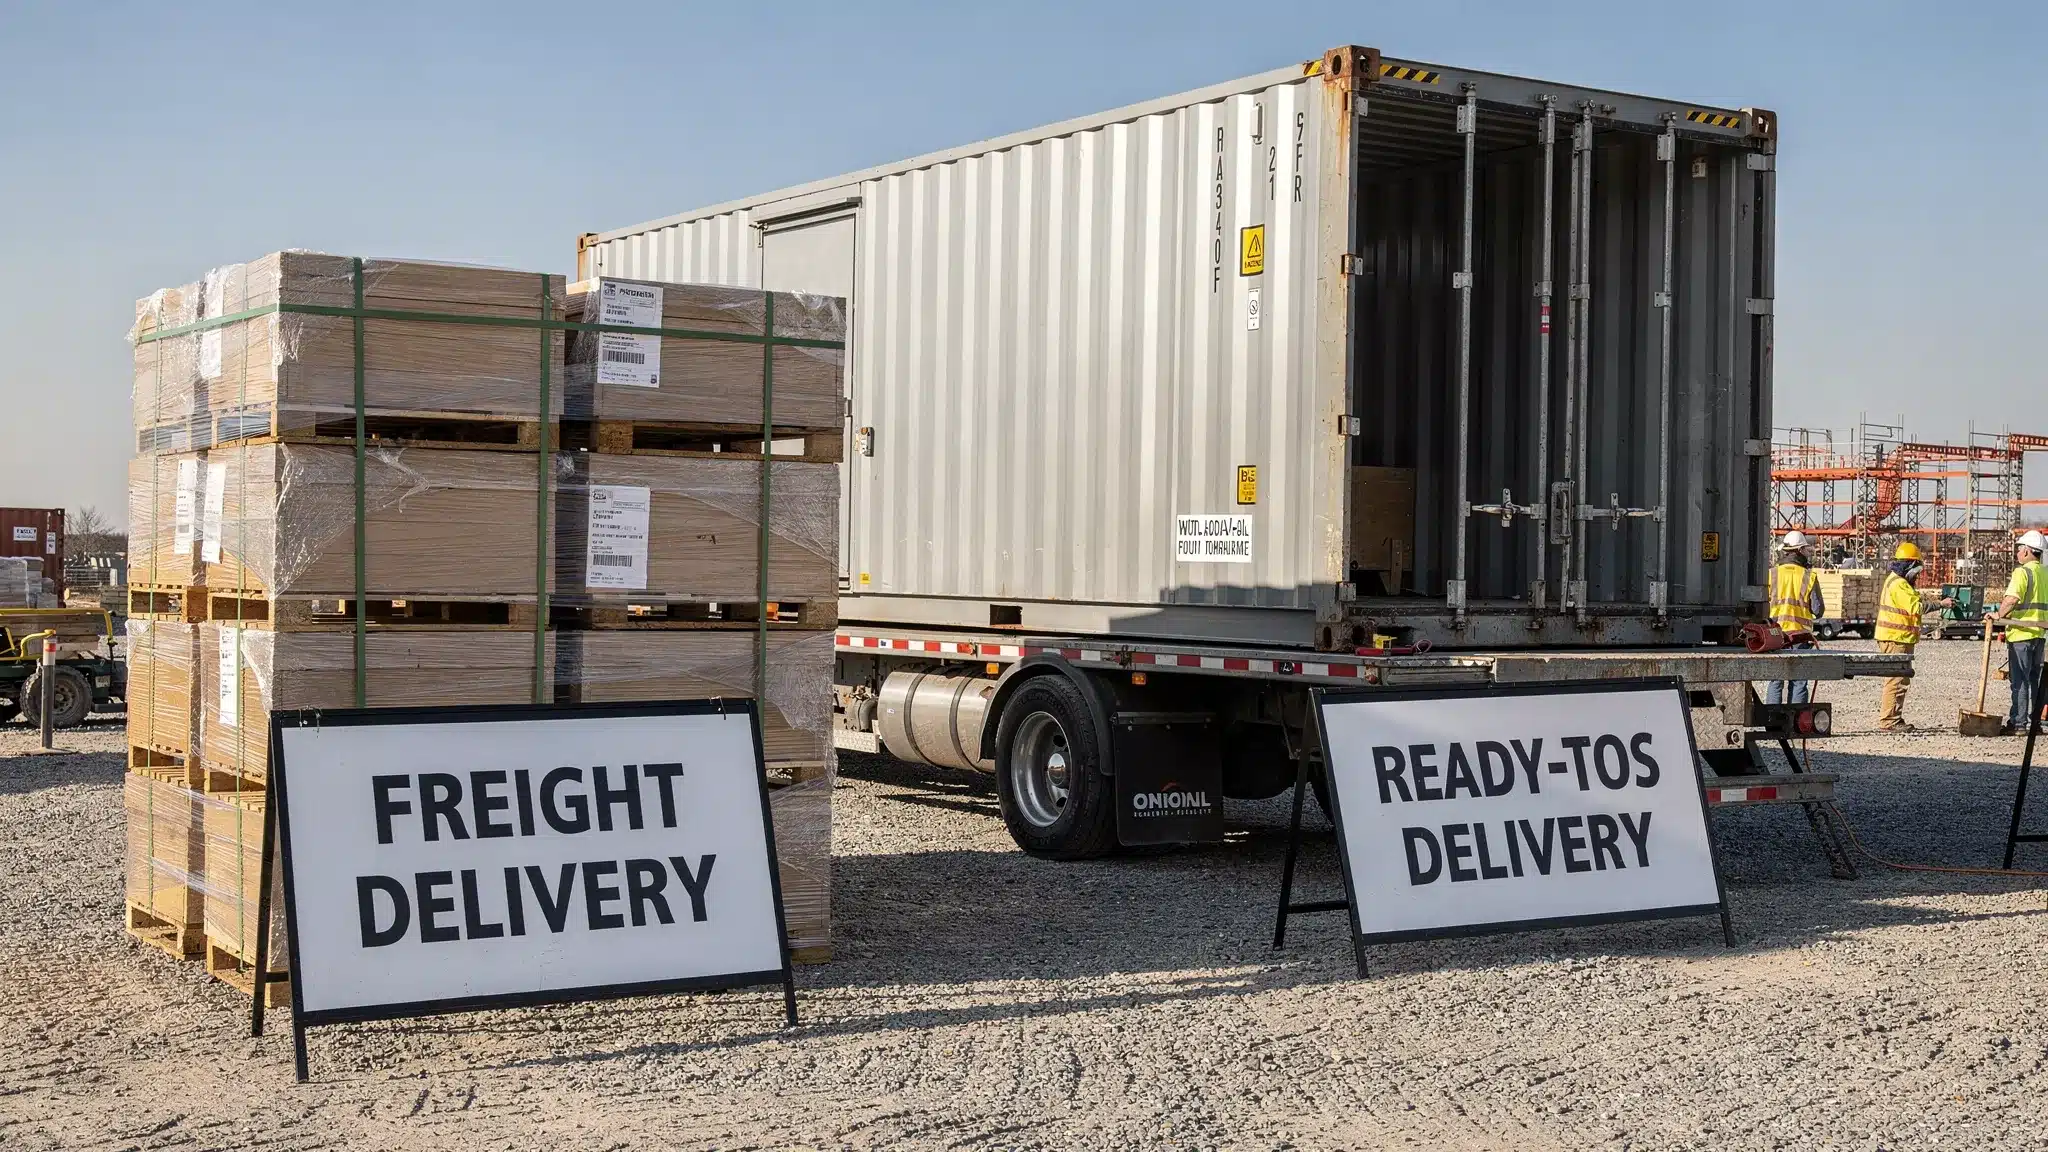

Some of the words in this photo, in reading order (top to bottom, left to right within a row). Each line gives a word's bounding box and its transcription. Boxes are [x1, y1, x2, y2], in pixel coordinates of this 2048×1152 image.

[372, 763, 684, 844] FREIGHT
[1372, 732, 1660, 804] READY-TOS
[1402, 811, 1652, 886] DELIVERY
[356, 854, 717, 948] DELIVERY
